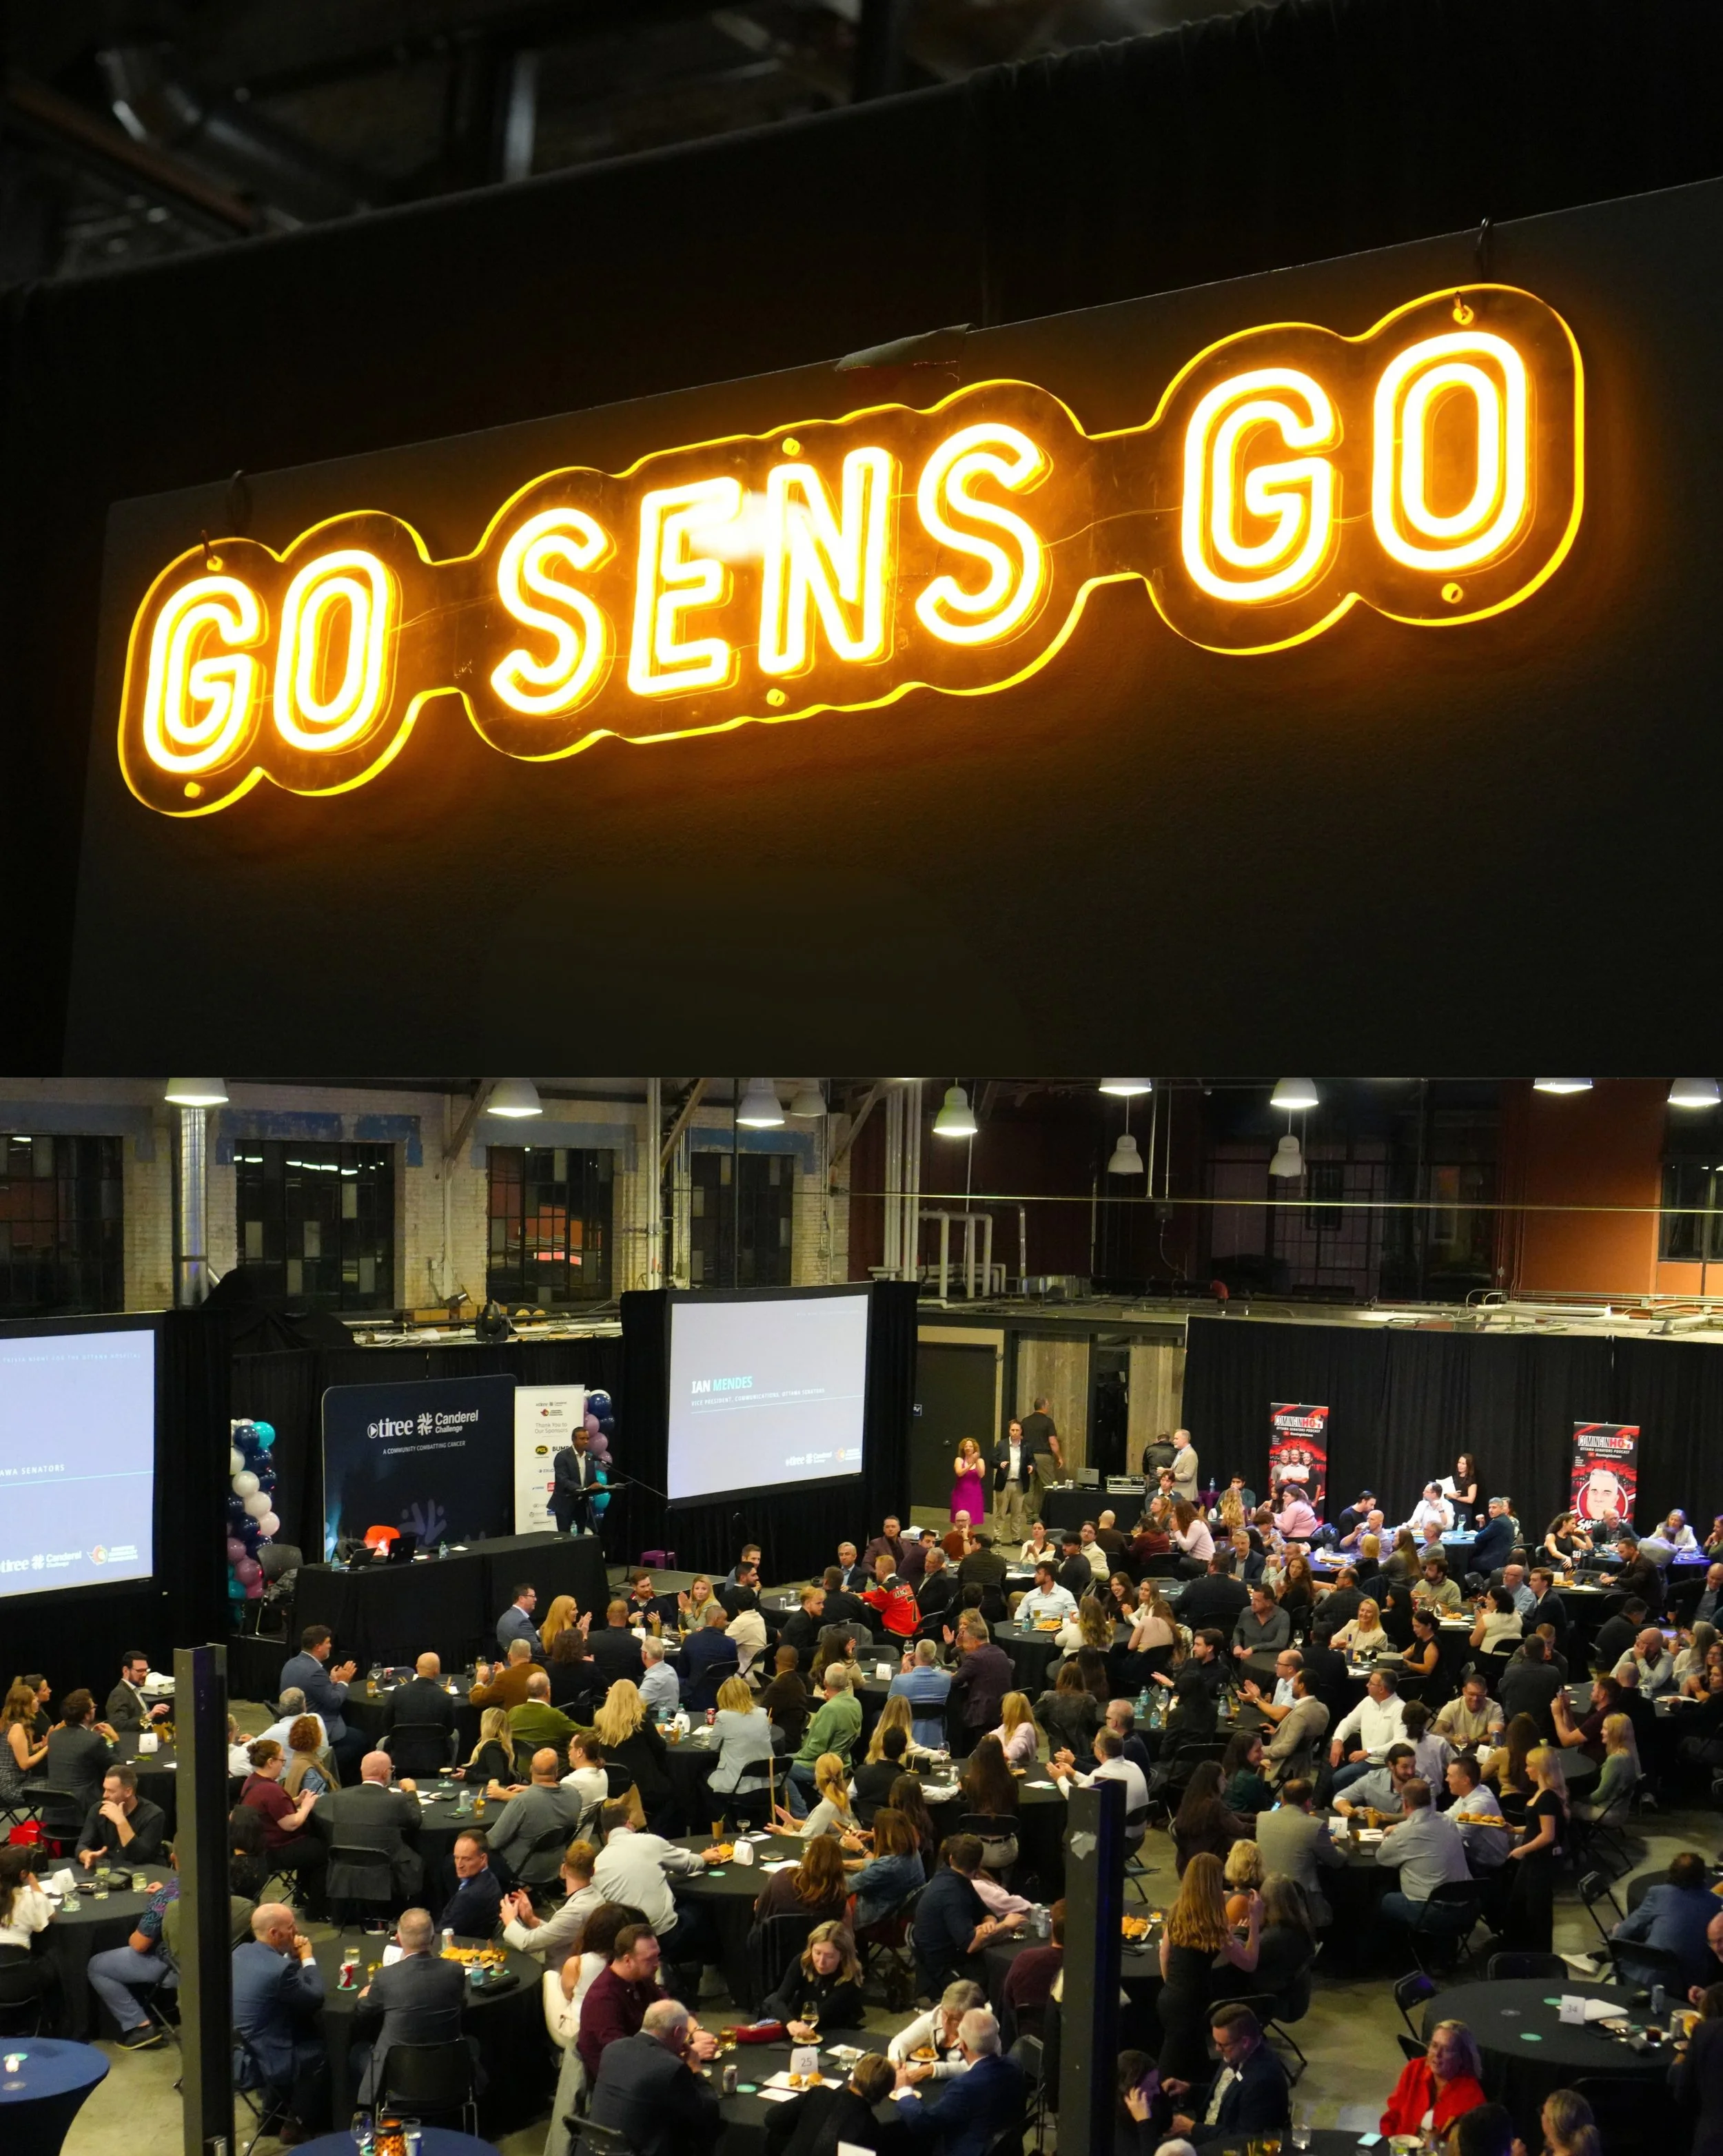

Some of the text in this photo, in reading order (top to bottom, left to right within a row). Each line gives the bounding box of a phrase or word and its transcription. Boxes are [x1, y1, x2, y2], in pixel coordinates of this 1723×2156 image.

[140, 329, 1533, 775] GO SENS GO
[691, 1376, 753, 1394] IAN MENDES
[435, 1410, 478, 1425] Canderel
[378, 1418, 414, 1438] tiree
[435, 1425, 463, 1434] Challenge
[387, 1445, 416, 1454] COMMUNITY
[416, 1442, 447, 1452] COMBATTING
[447, 1440, 466, 1448] CANCER
[21, 1464, 65, 1475] SENATORS
[1566, 2004, 1578, 2013] 34
[801, 2057, 812, 2067] 25
